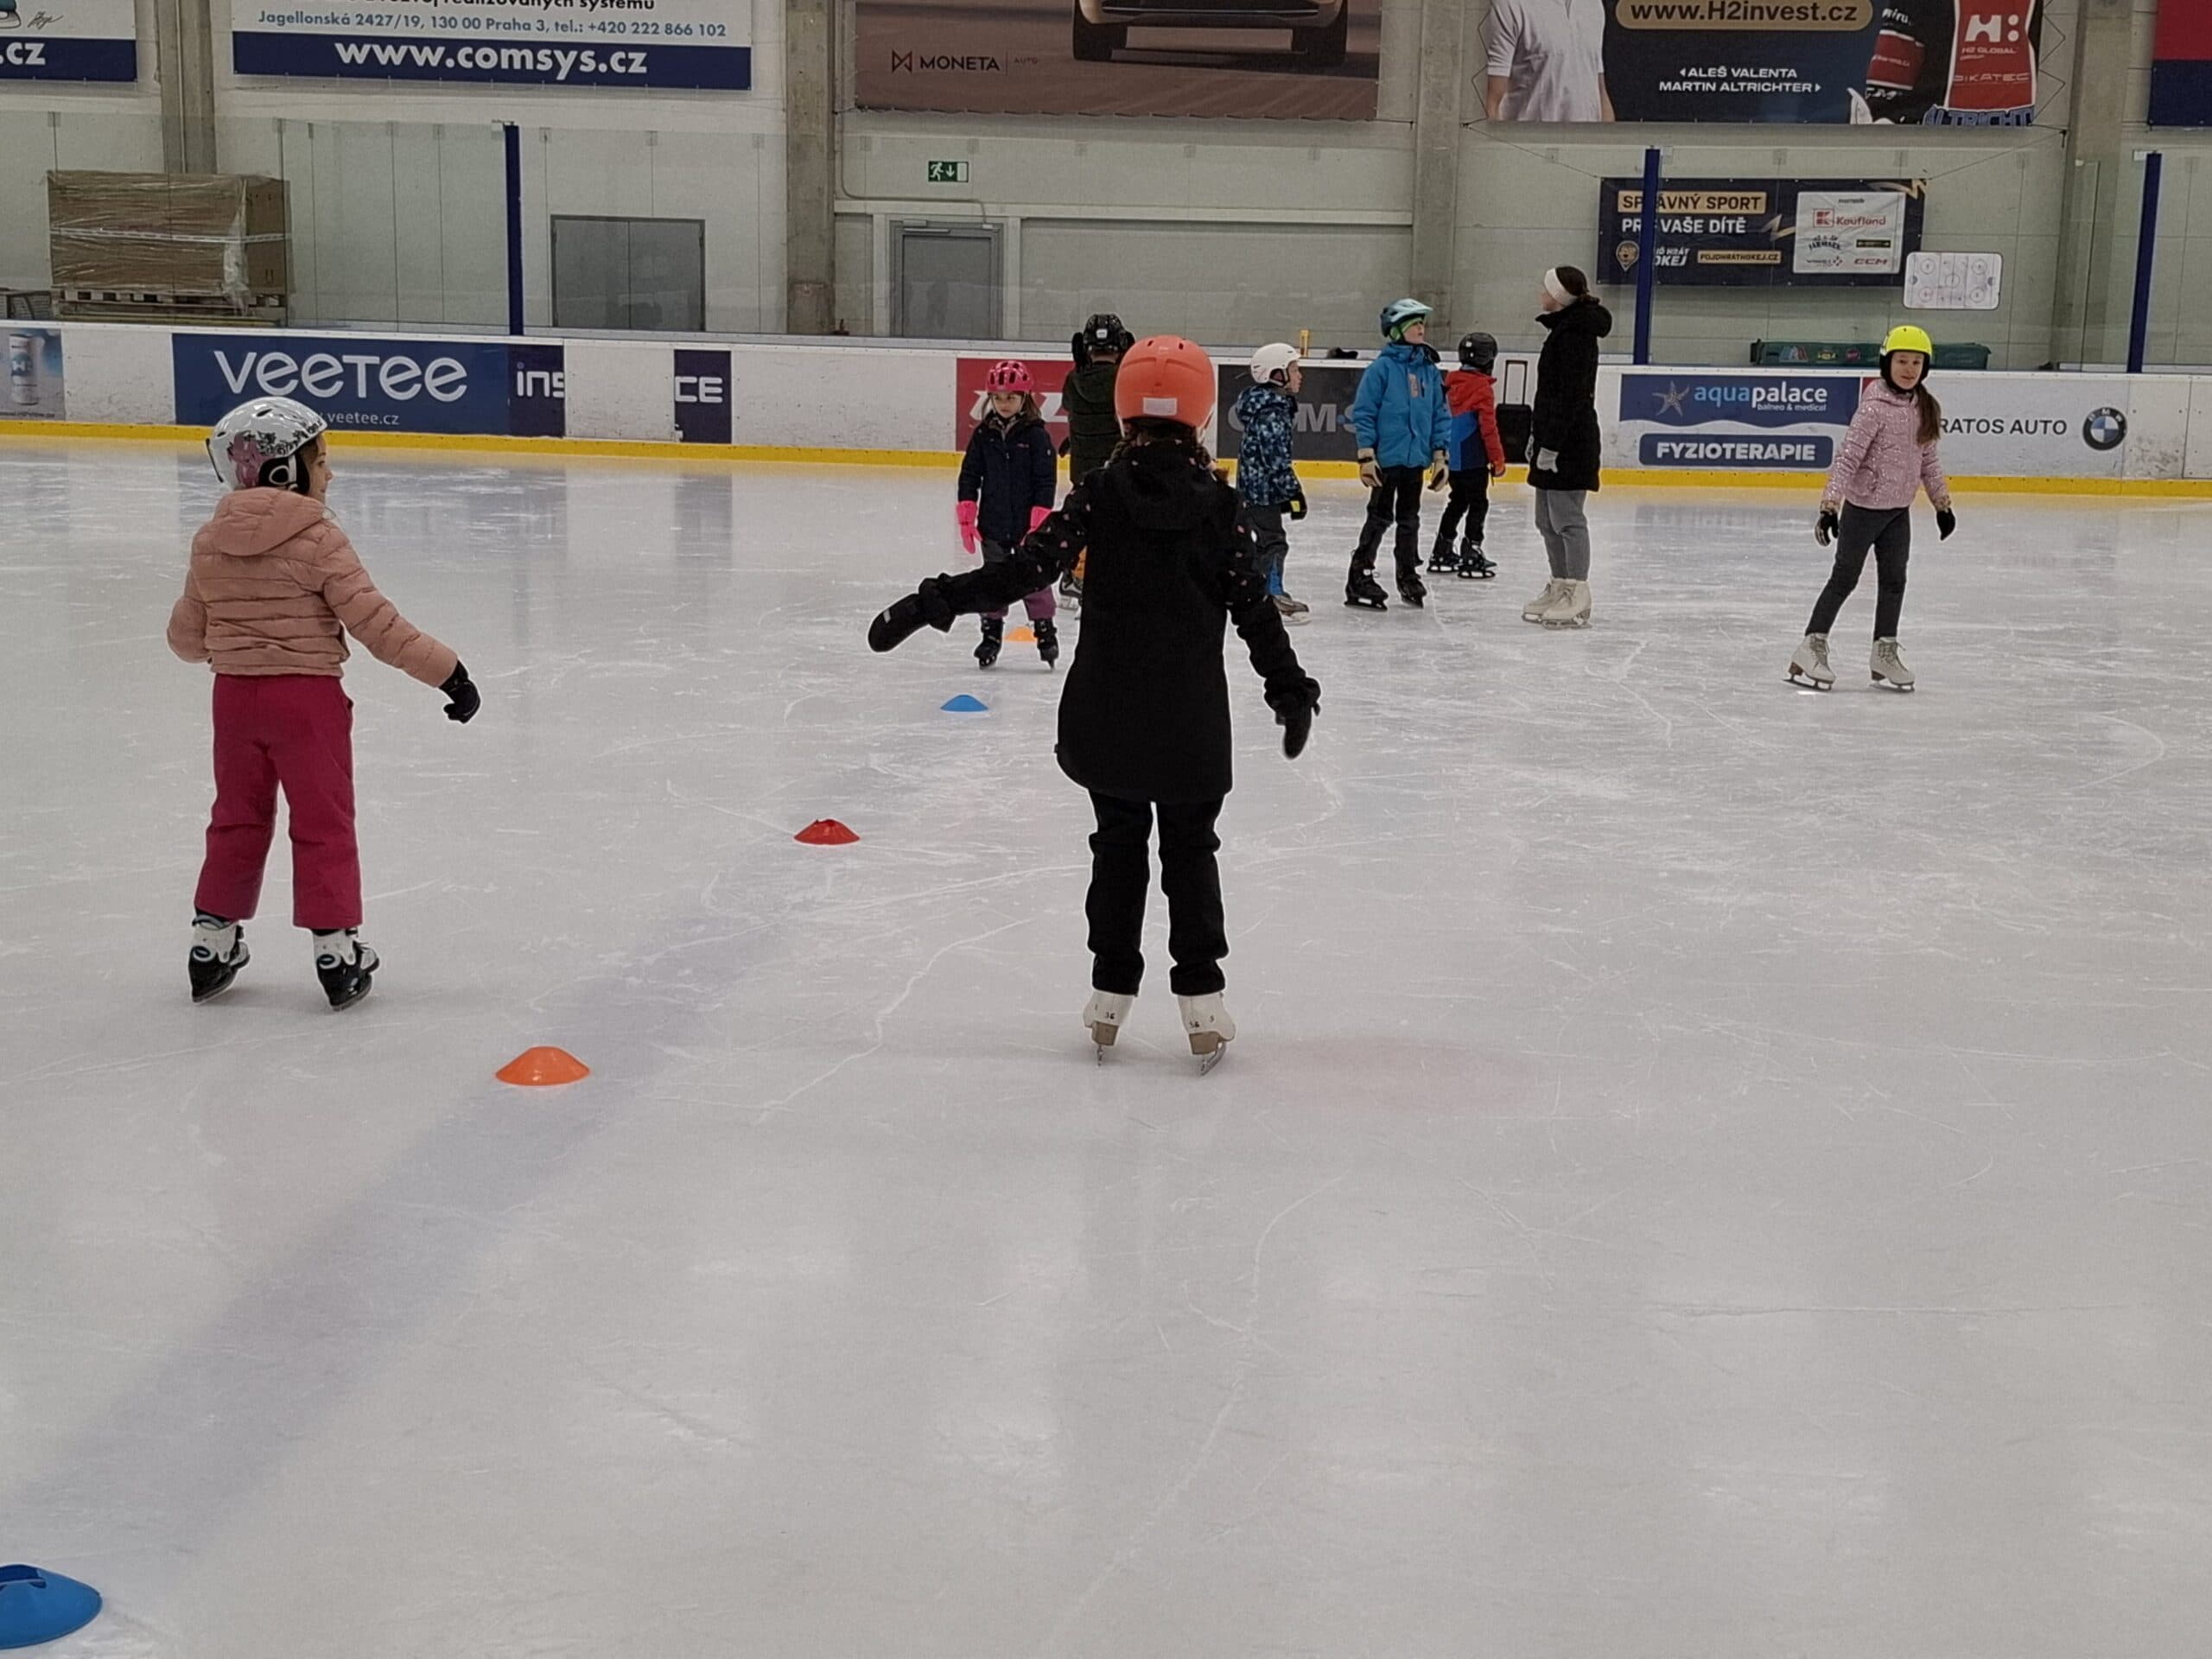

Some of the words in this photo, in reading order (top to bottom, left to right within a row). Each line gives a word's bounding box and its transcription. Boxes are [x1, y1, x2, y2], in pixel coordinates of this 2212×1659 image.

[1630, 0, 1857, 22] www.H2invest.cz
[258, 10, 351, 27] Jagellonská
[355, 14, 425, 29] 2427/19,
[431, 16, 458, 29] 130
[461, 17, 482, 29] 00
[486, 18, 531, 32] Praha
[536, 19, 550, 33] 3,
[555, 19, 583, 33] tel.:
[588, 21, 627, 35] +420
[631, 22, 660, 35] 222
[664, 22, 693, 36] 866
[699, 23, 727, 36] 102
[334, 42, 648, 80] www.comsys.cz
[919, 55, 1001, 71] MONETA
[1688, 66, 1727, 78] ALEŠ
[1730, 68, 1797, 79] VALENTA
[1659, 81, 1716, 92] MARTIN
[1719, 81, 1813, 92] ALTRICHTER
[1623, 194, 1700, 209] SPÁVNÝ
[1707, 196, 1762, 210] SPORT
[1622, 219, 1656, 232] PR
[1661, 216, 1703, 233] VAŠE
[1709, 216, 1746, 233] DÍTĚ
[1694, 381, 1827, 408] aquapalace
[2010, 420, 2068, 435] AUTO
[1656, 442, 1816, 461] FYZIOTERAPIE
